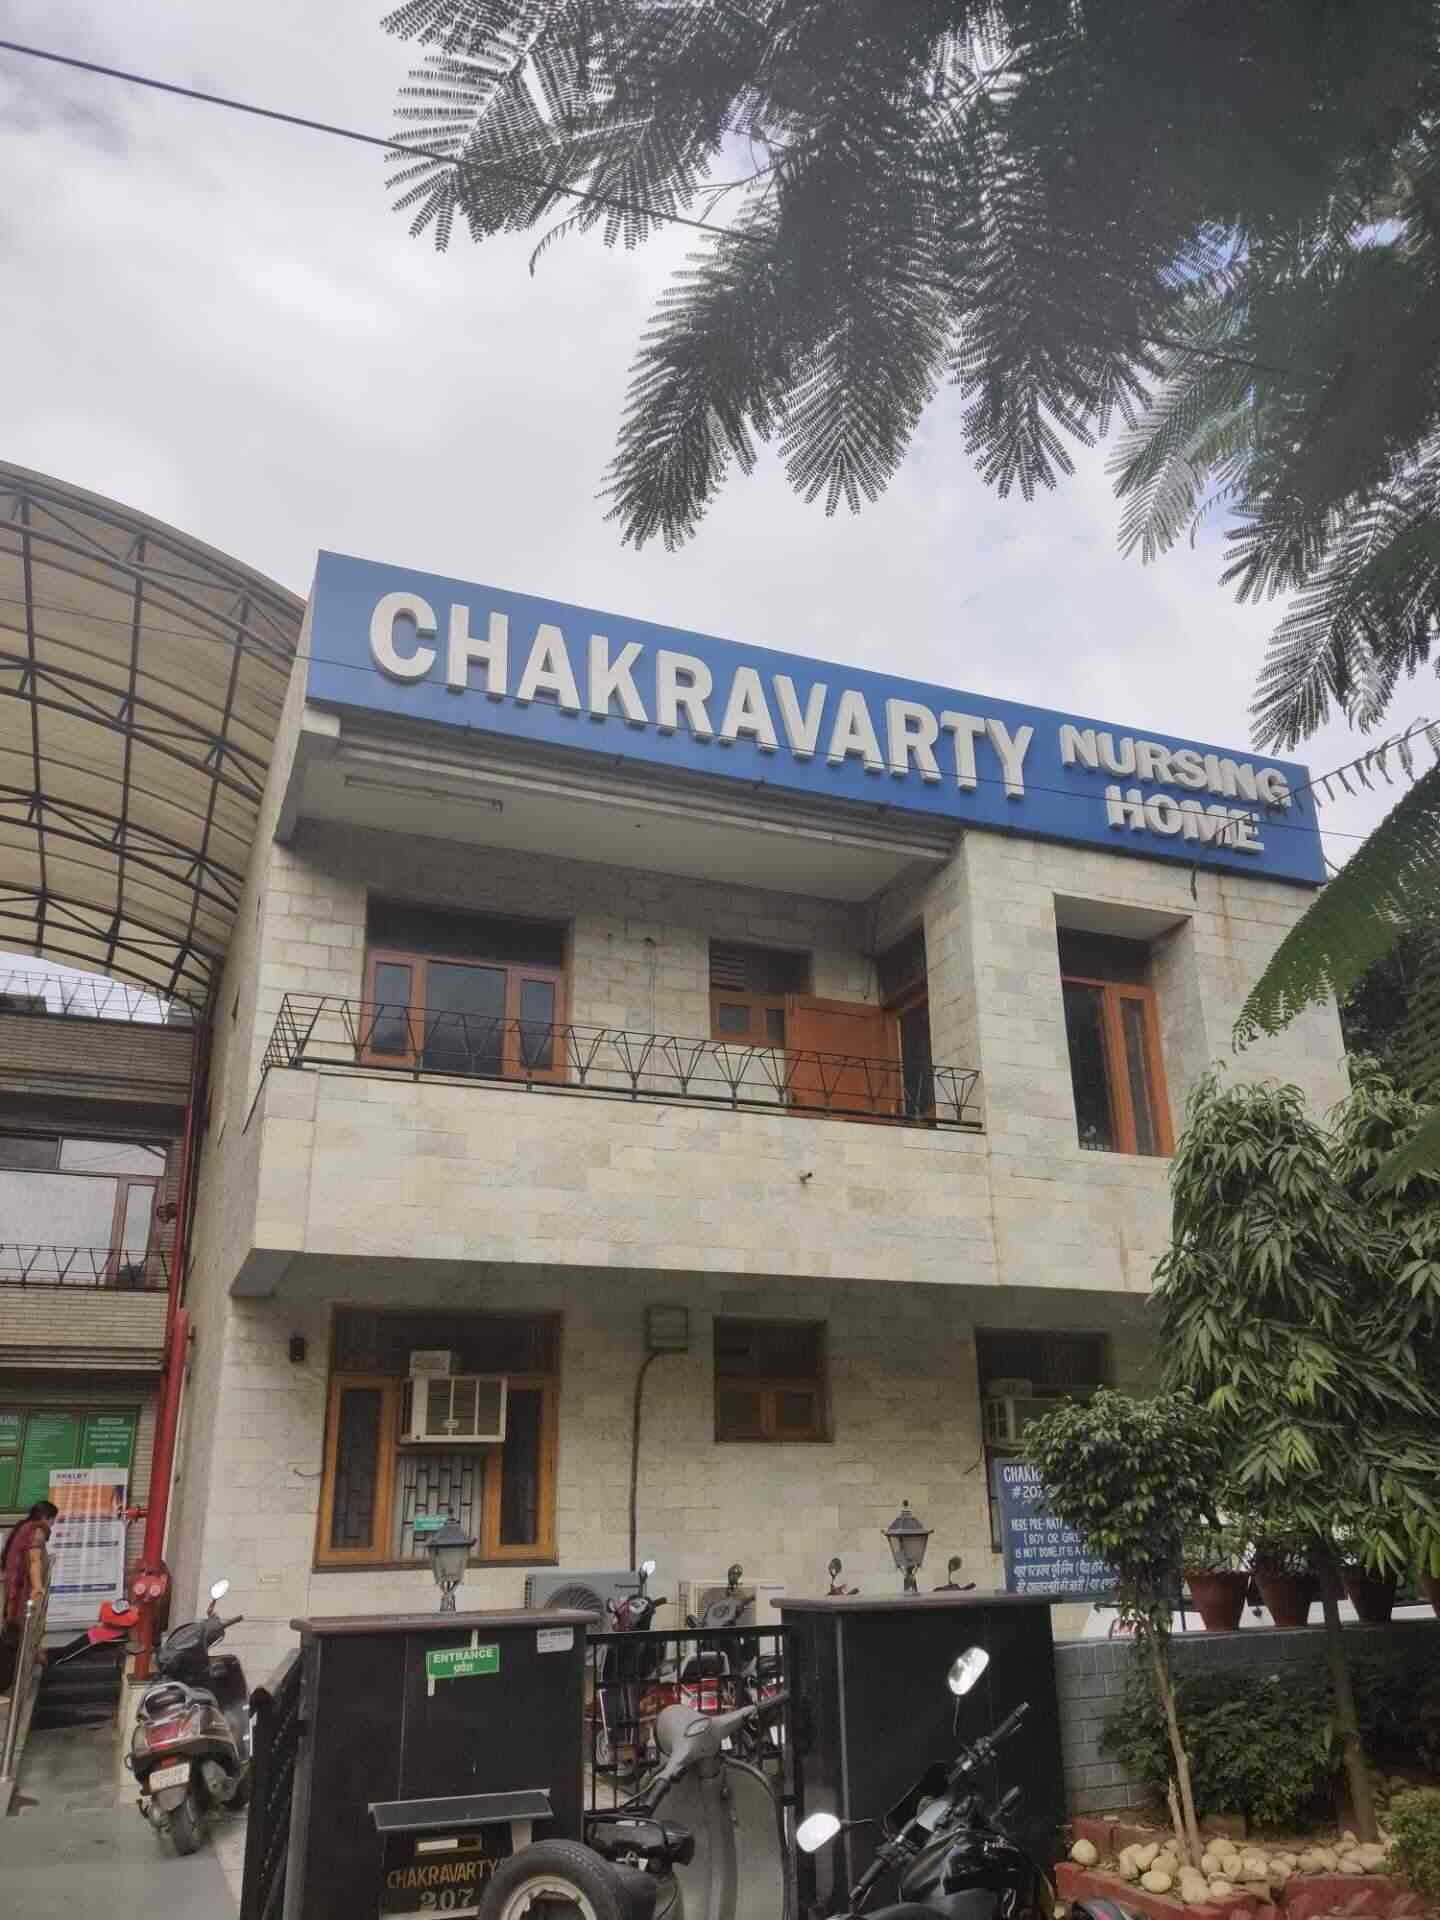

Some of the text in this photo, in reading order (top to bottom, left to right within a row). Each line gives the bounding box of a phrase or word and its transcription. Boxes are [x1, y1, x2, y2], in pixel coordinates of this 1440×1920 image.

[369, 591, 1292, 806] CHAKRAVARTY NURSING
[1104, 785, 1265, 854] HOME
[1047, 1532, 1059, 1545] OR
[1023, 1547, 1037, 1559] NOT
[433, 1648, 494, 1664] ENTRANCE
[386, 1858, 498, 1889] CHAKRAVARTY
[420, 1888, 475, 1912] 207
